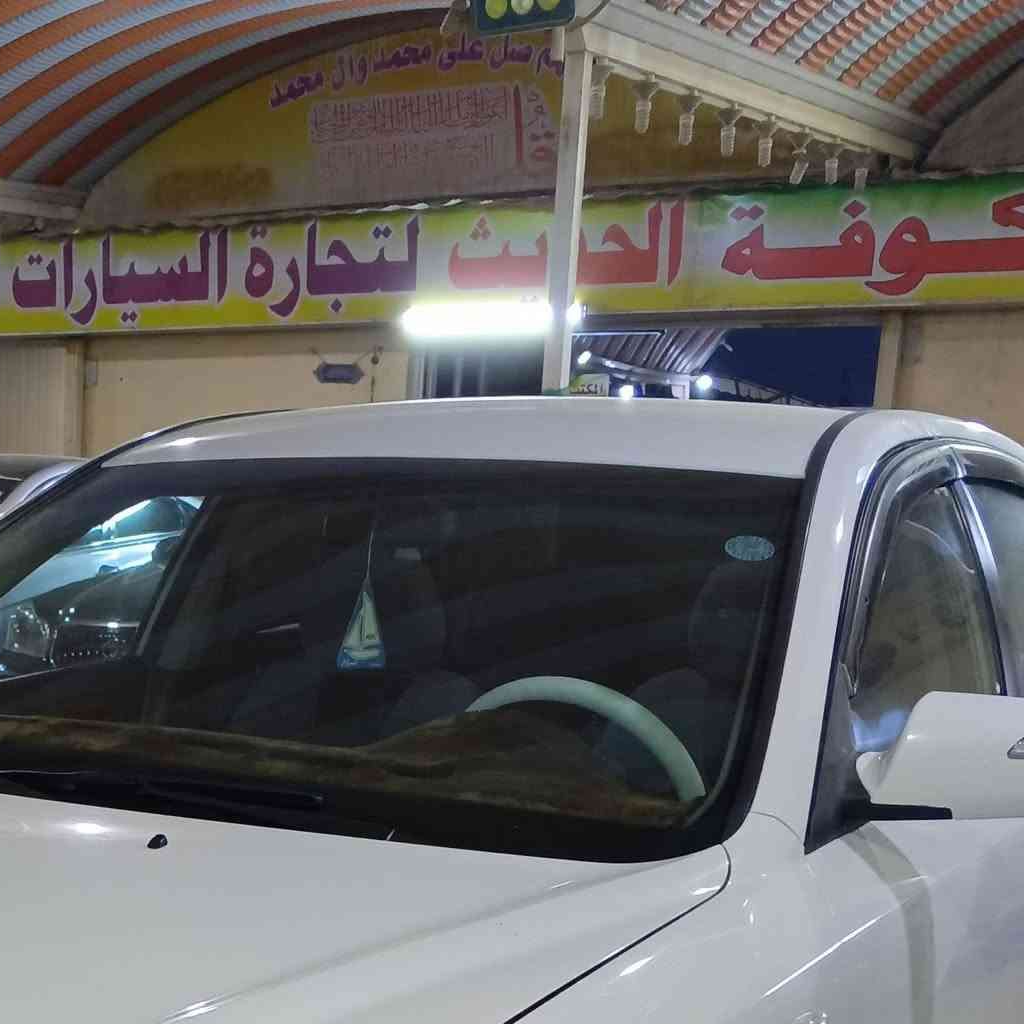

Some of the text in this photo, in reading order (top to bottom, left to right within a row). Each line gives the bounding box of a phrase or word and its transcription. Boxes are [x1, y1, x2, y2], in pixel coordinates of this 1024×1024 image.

[372, 43, 432, 73] محمد
[437, 31, 484, 71] على
[270, 70, 324, 108] محمد
[11, 224, 229, 326] السيارات
[244, 214, 421, 318] لتجارة
